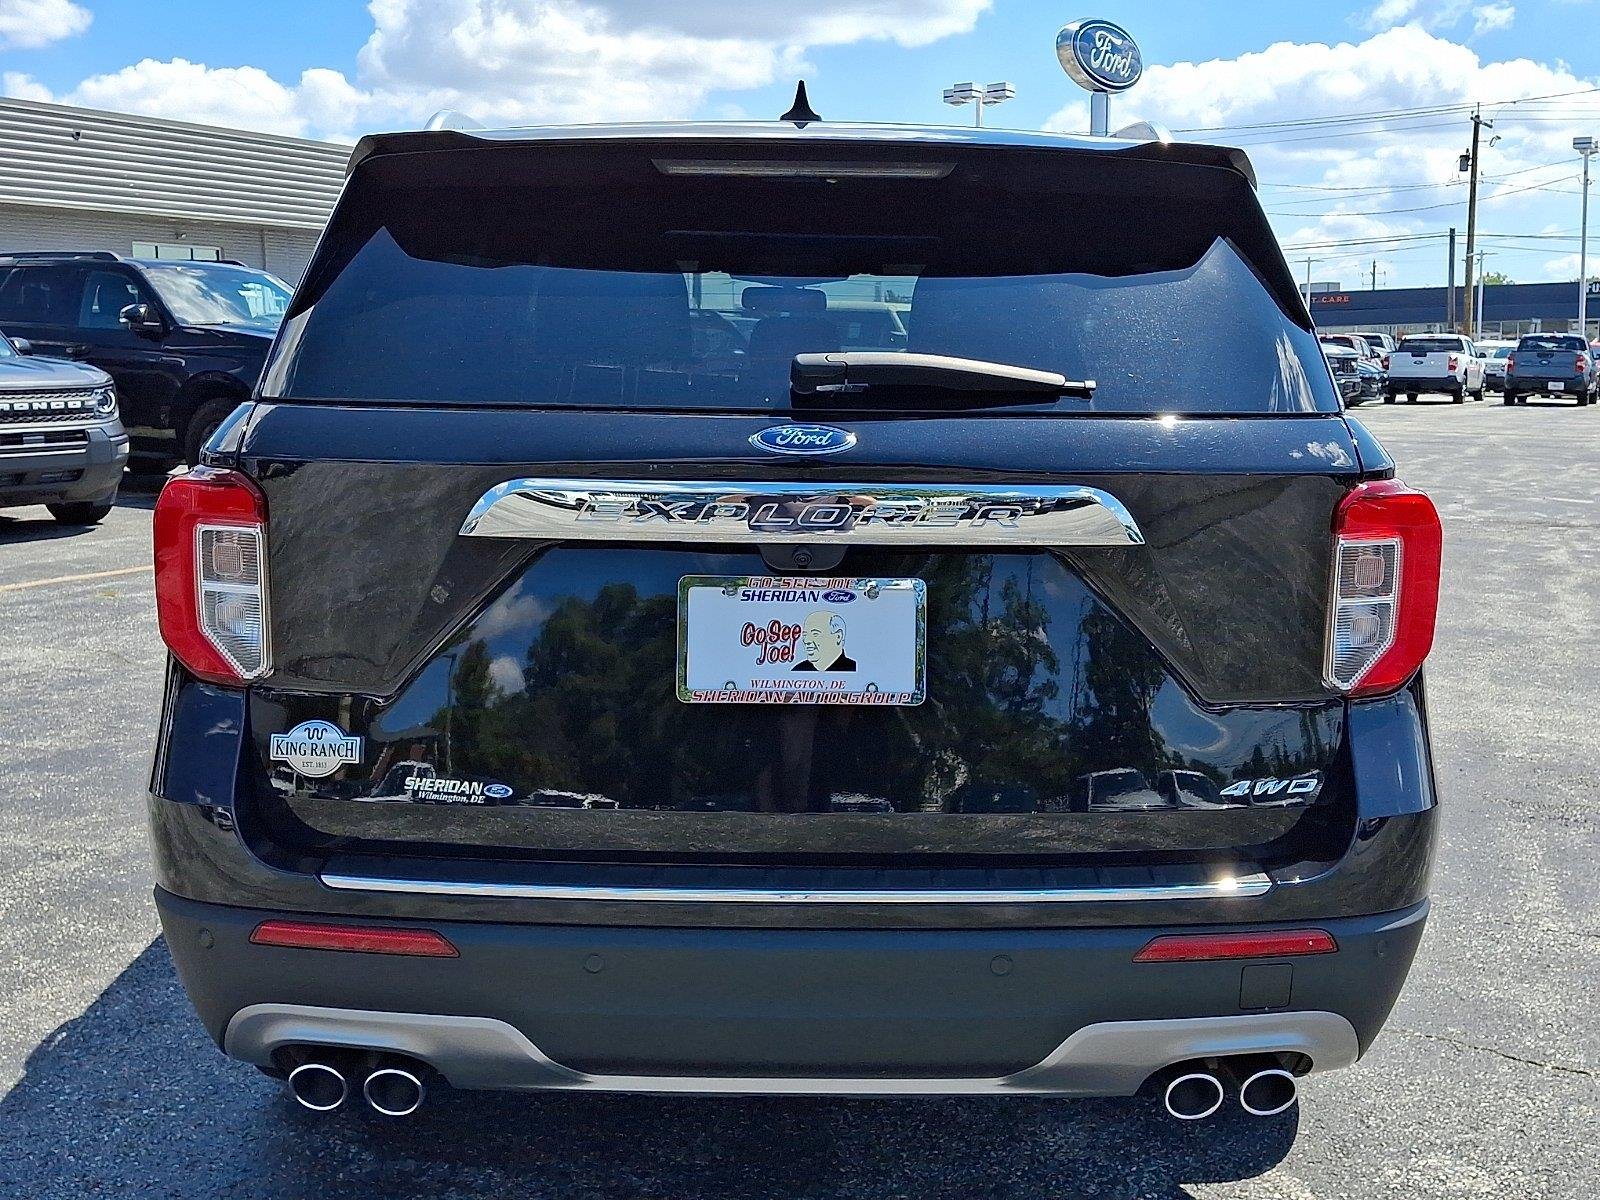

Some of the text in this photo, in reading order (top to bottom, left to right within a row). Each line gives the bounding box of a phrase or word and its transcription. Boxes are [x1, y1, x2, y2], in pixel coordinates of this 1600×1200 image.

[1090, 30, 1132, 78] Ford
[1321, 295, 1350, 304] CARE
[775, 427, 833, 446] Ford
[574, 498, 1026, 530] EXPLORER
[747, 577, 855, 590] GO SEE JOE
[740, 589, 821, 603] SHERIDAN
[740, 619, 802, 648] Go See
[756, 640, 795, 666] Joe!
[830, 680, 847, 690] DE
[691, 690, 912, 704] SHERIDAN AUTO GROUP
[275, 739, 355, 758] KING RANCH
[403, 776, 484, 796] SHERIDAN
[1219, 779, 1318, 797] 4WD
[418, 790, 487, 804] Wilmington, DE
